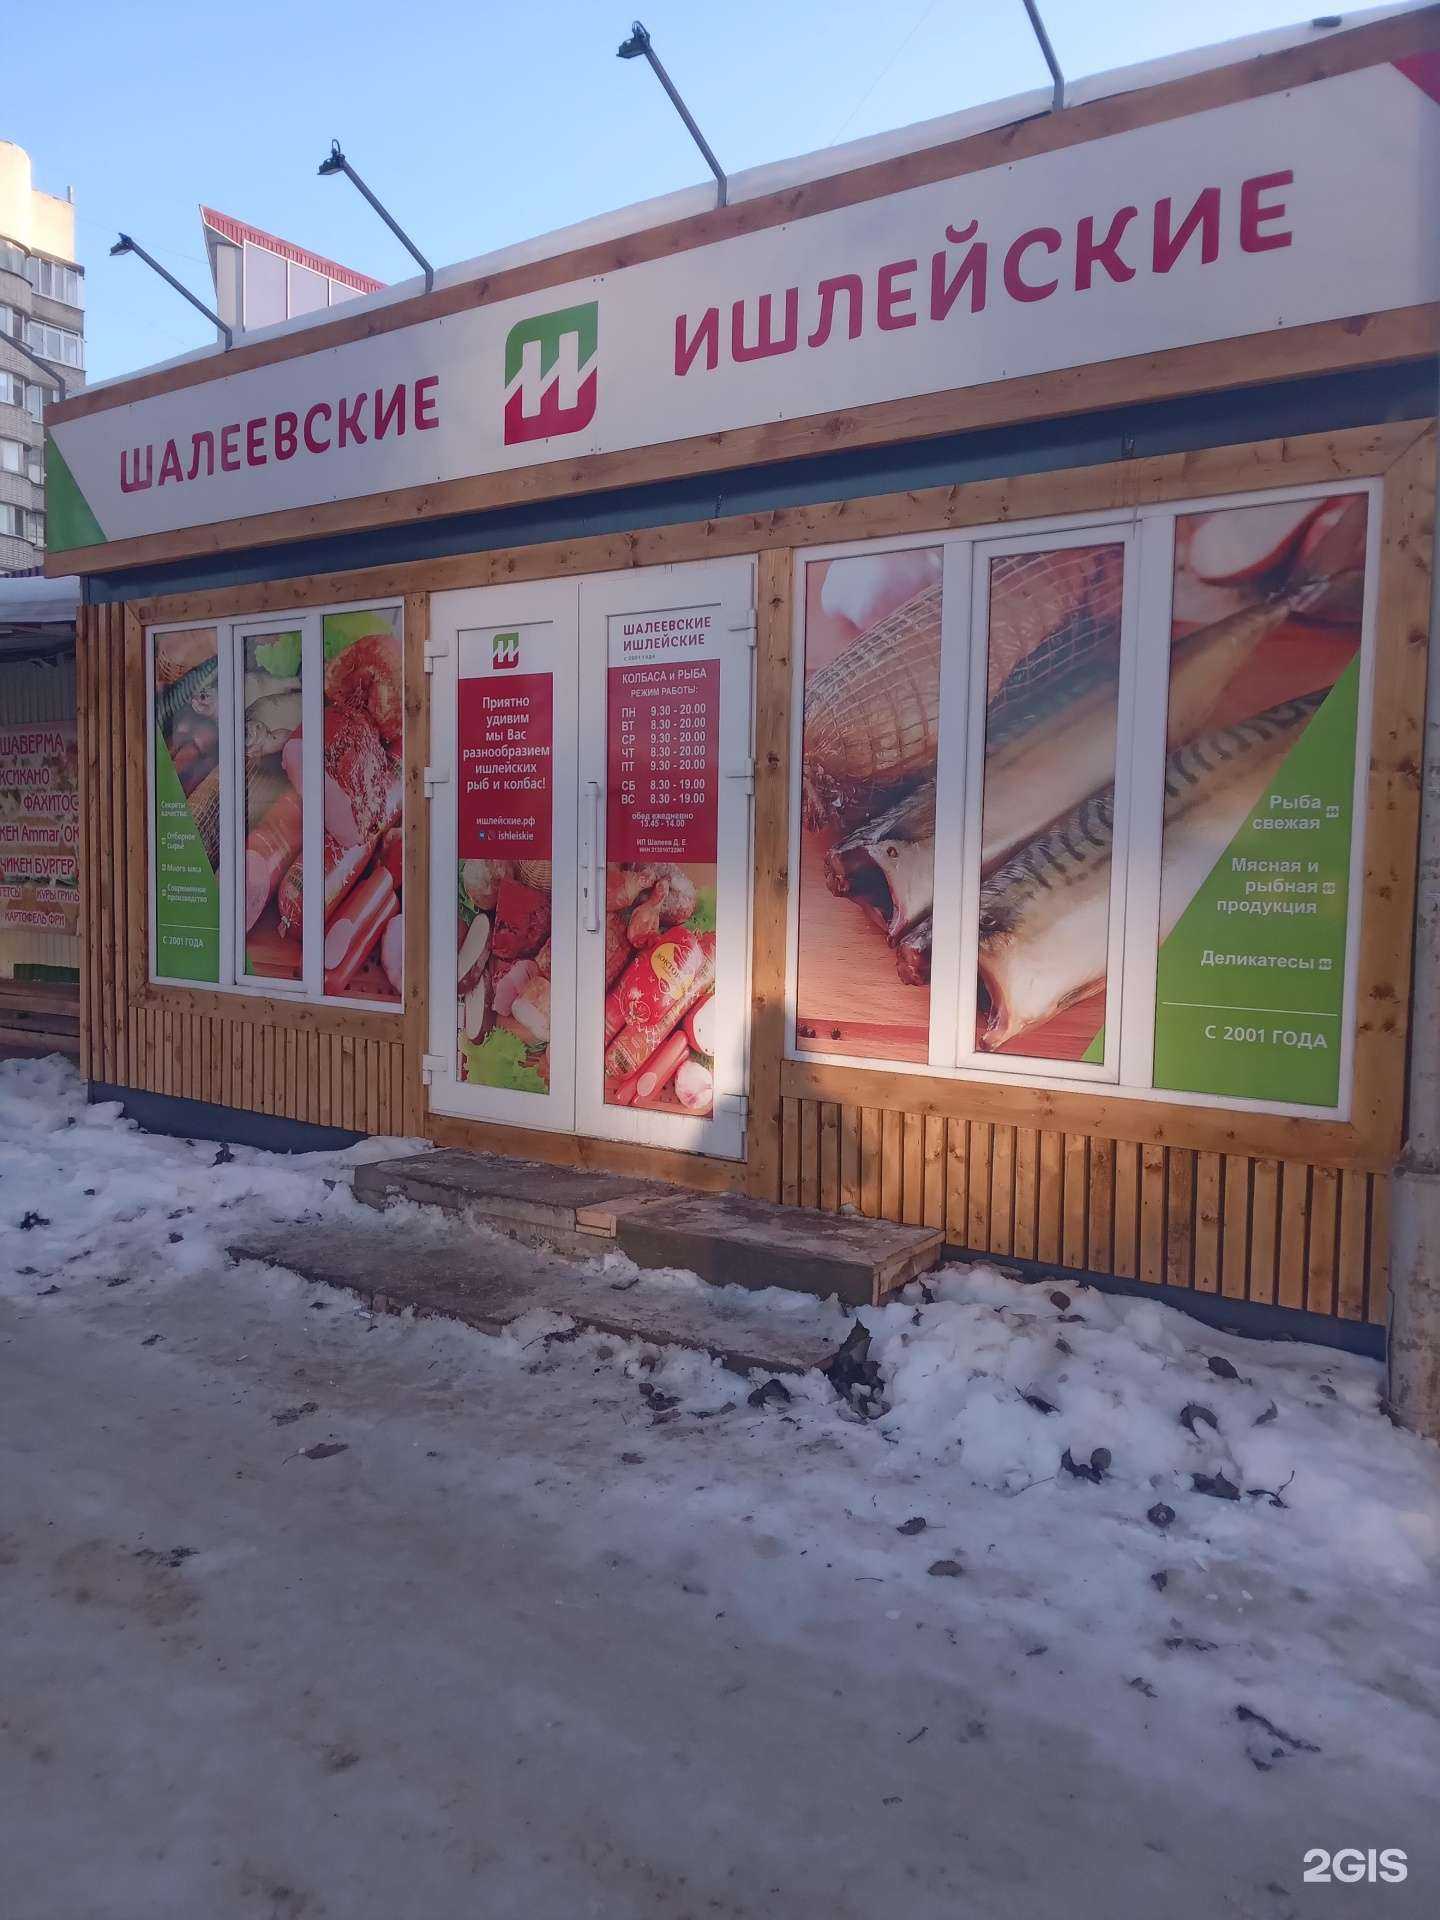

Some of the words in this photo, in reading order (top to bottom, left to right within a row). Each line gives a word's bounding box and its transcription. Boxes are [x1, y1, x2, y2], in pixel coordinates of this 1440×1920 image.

[119, 374, 440, 494] ШАЛЕЕВСКИЕ
[674, 169, 1295, 377] ИШЛЕЙСКИЕ
[623, 616, 712, 636] ШАЛЕЕВСКИЕ
[623, 632, 705, 652] ИШЛЕЙСКИЕ
[622, 671, 667, 685] КОЛБАСА
[669, 673, 675, 681] и
[677, 668, 707, 680] РЫБА
[630, 687, 660, 698] РЕЖИМ
[482, 696, 530, 710] Приятно
[621, 707, 636, 718] ПН
[680, 703, 706, 715] 20.00
[486, 713, 529, 728] удивим
[621, 720, 635, 731] ВТ
[680, 717, 706, 729] 20.00
[485, 731, 503, 742] мы
[507, 729, 527, 741] Вас
[621, 734, 636, 745] СР
[680, 731, 706, 742] 20.00
[463, 745, 550, 762] разнообразием
[621, 748, 635, 759] ЧТ
[680, 745, 706, 756] 20.00
[475, 761, 537, 774] ишлейских
[621, 761, 635, 772] ПТ
[680, 759, 706, 770] 20.00
[466, 778, 489, 793] рыб
[493, 781, 500, 790] и
[503, 777, 546, 790] колбас!
[621, 780, 636, 791] СБ
[680, 779, 705, 789] 19.00
[621, 794, 636, 804] ВС
[680, 793, 705, 803] 19.00
[1270, 795, 1321, 809] Рыба
[476, 816, 536, 828] ишлейские.рф
[1252, 815, 1321, 830] свежая
[498, 831, 534, 841] ishleiskie
[35, 858, 75, 875] БУРГЕР
[1231, 857, 1301, 873] Мясная
[1308, 861, 1319, 872] и
[1245, 879, 1318, 895] рыбная
[1217, 900, 1317, 916] продукция
[5, 911, 47, 924] КАРТОФЕЛЬ
[1200, 950, 1315, 970] Деликатесы
[1205, 1025, 1217, 1039] С
[1223, 1026, 1266, 1043] 2001
[1272, 1030, 1328, 1049] ГОДА
